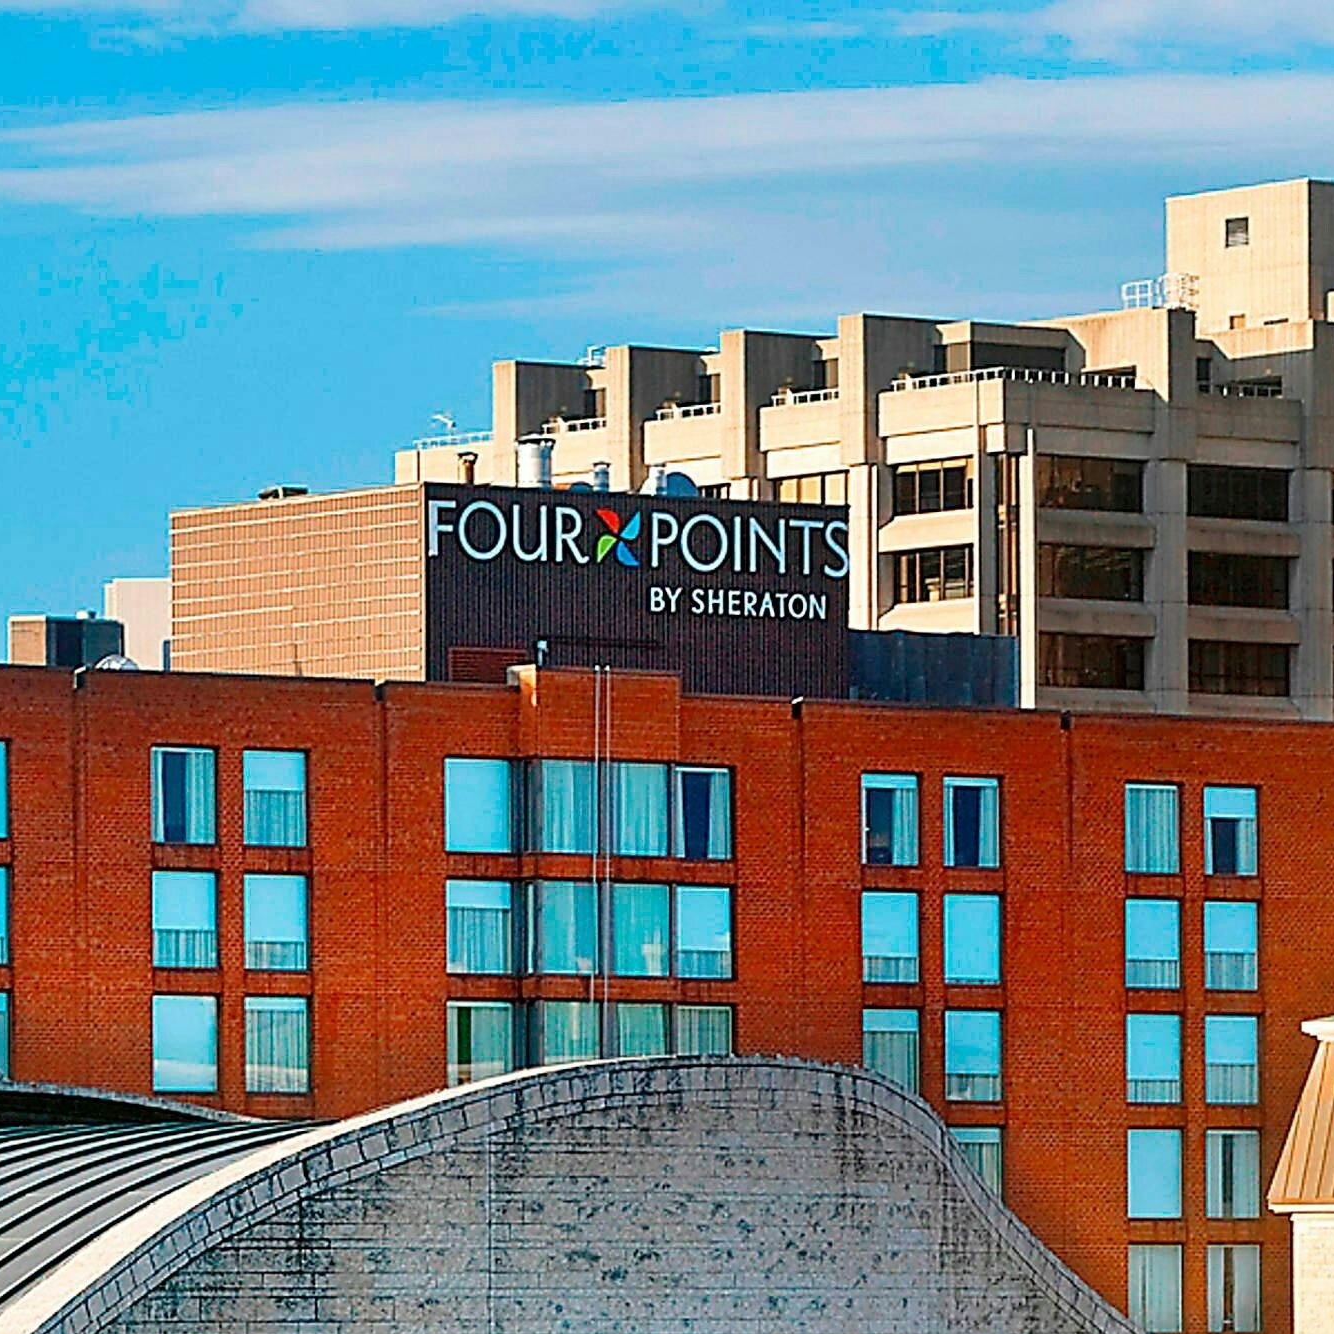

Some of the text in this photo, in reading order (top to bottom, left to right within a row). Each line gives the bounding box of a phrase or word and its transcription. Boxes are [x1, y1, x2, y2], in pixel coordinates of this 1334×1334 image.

[427, 499, 849, 580] FOUR POINTS
[650, 586, 827, 619] BY SHERATON
